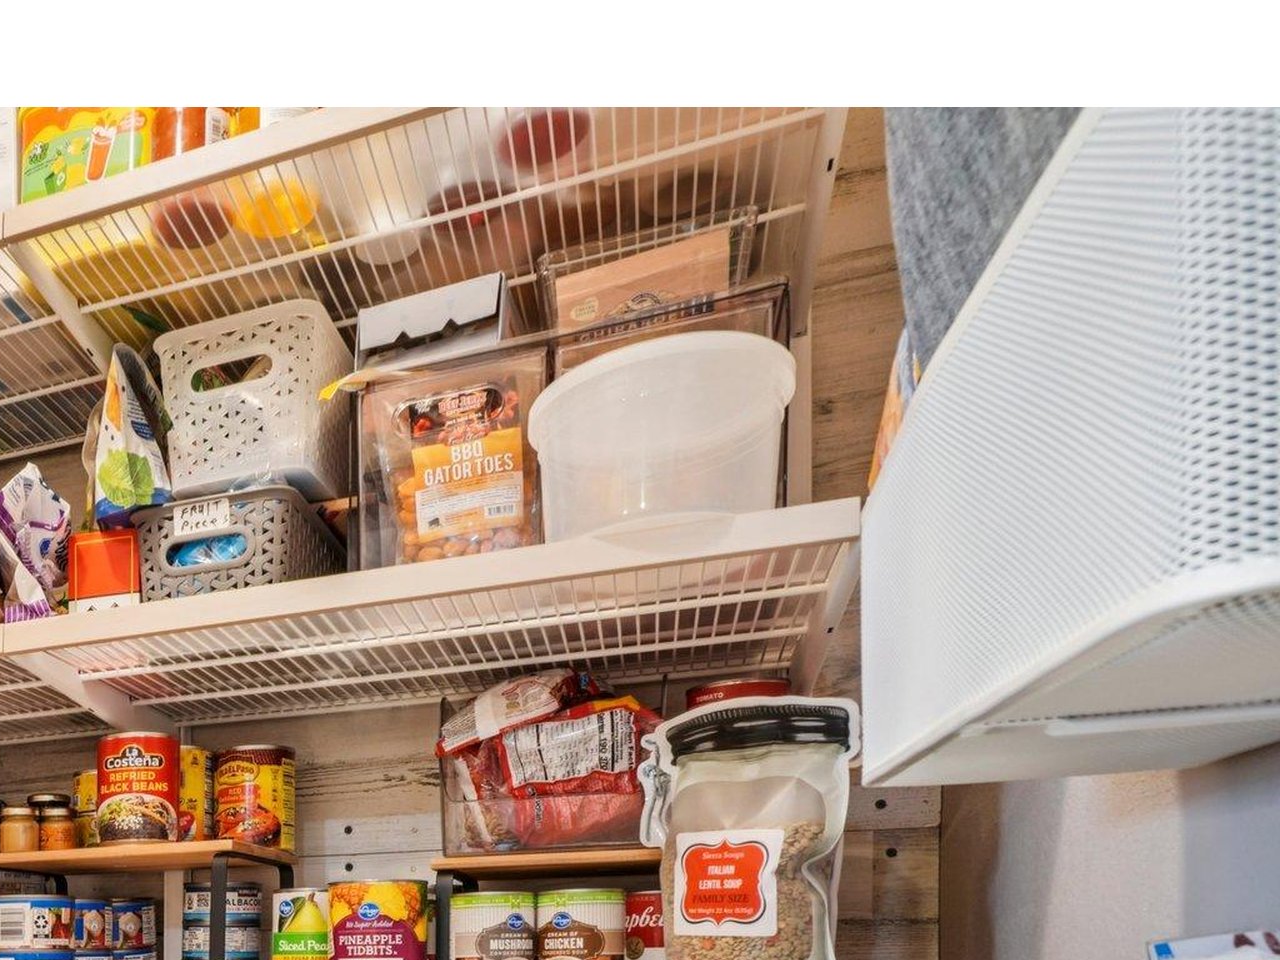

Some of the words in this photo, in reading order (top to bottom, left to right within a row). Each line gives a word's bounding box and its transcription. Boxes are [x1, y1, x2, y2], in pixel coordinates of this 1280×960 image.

[451, 440, 484, 463] BBQ
[424, 461, 473, 486] GATOR
[475, 453, 514, 475] TOES
[181, 500, 221, 519] FRUIT
[126, 748, 138, 757] La
[110, 771, 156, 782] REFRIED
[132, 781, 169, 792] BEANS
[723, 878, 743, 889] SOUP
[692, 894, 725, 904] FAMILY
[727, 893, 750, 904] SIZE
[307, 939, 330, 952] Pea
[339, 933, 403, 946] PINEAPPLE
[544, 937, 584, 950] CHICKEN
[346, 945, 394, 956] TIDBITS
